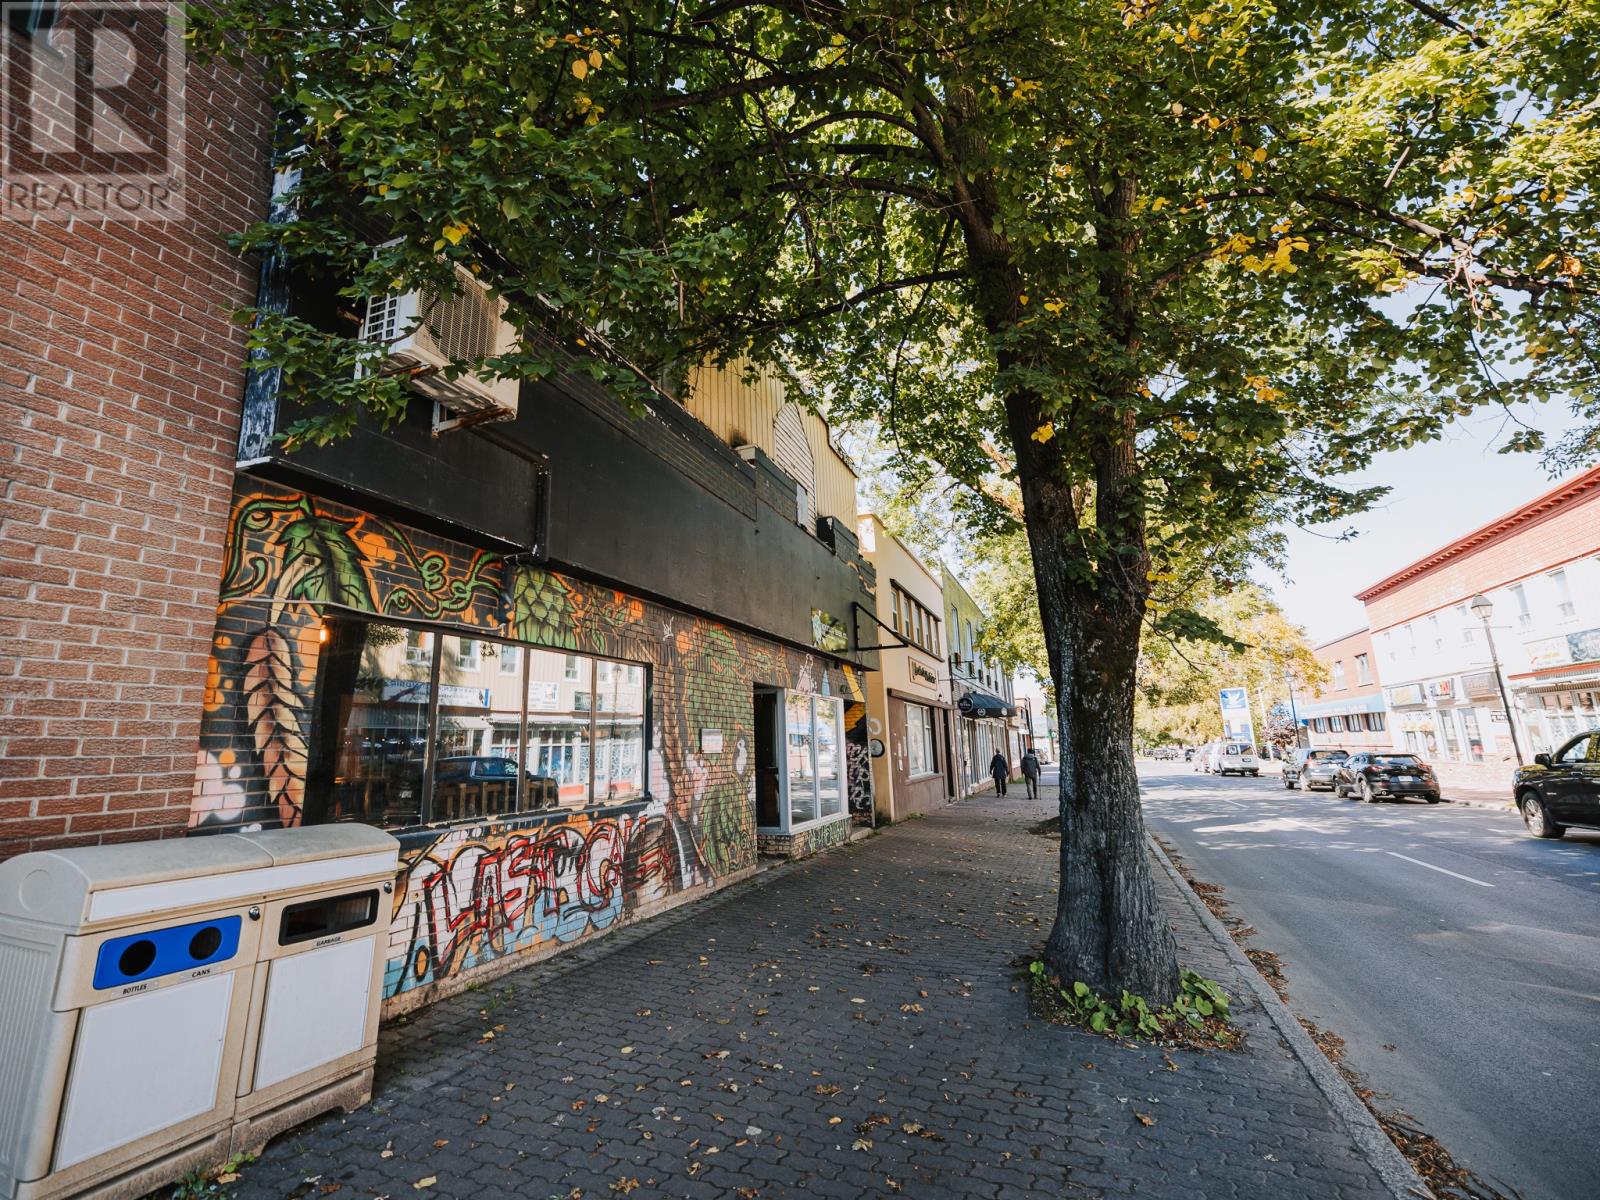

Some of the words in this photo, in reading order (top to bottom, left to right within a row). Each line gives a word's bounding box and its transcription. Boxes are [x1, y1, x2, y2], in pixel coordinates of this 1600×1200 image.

[316, 936, 342, 947] GARBAGE
[191, 968, 211, 978] CANS
[122, 983, 148, 995] BOTTLES
